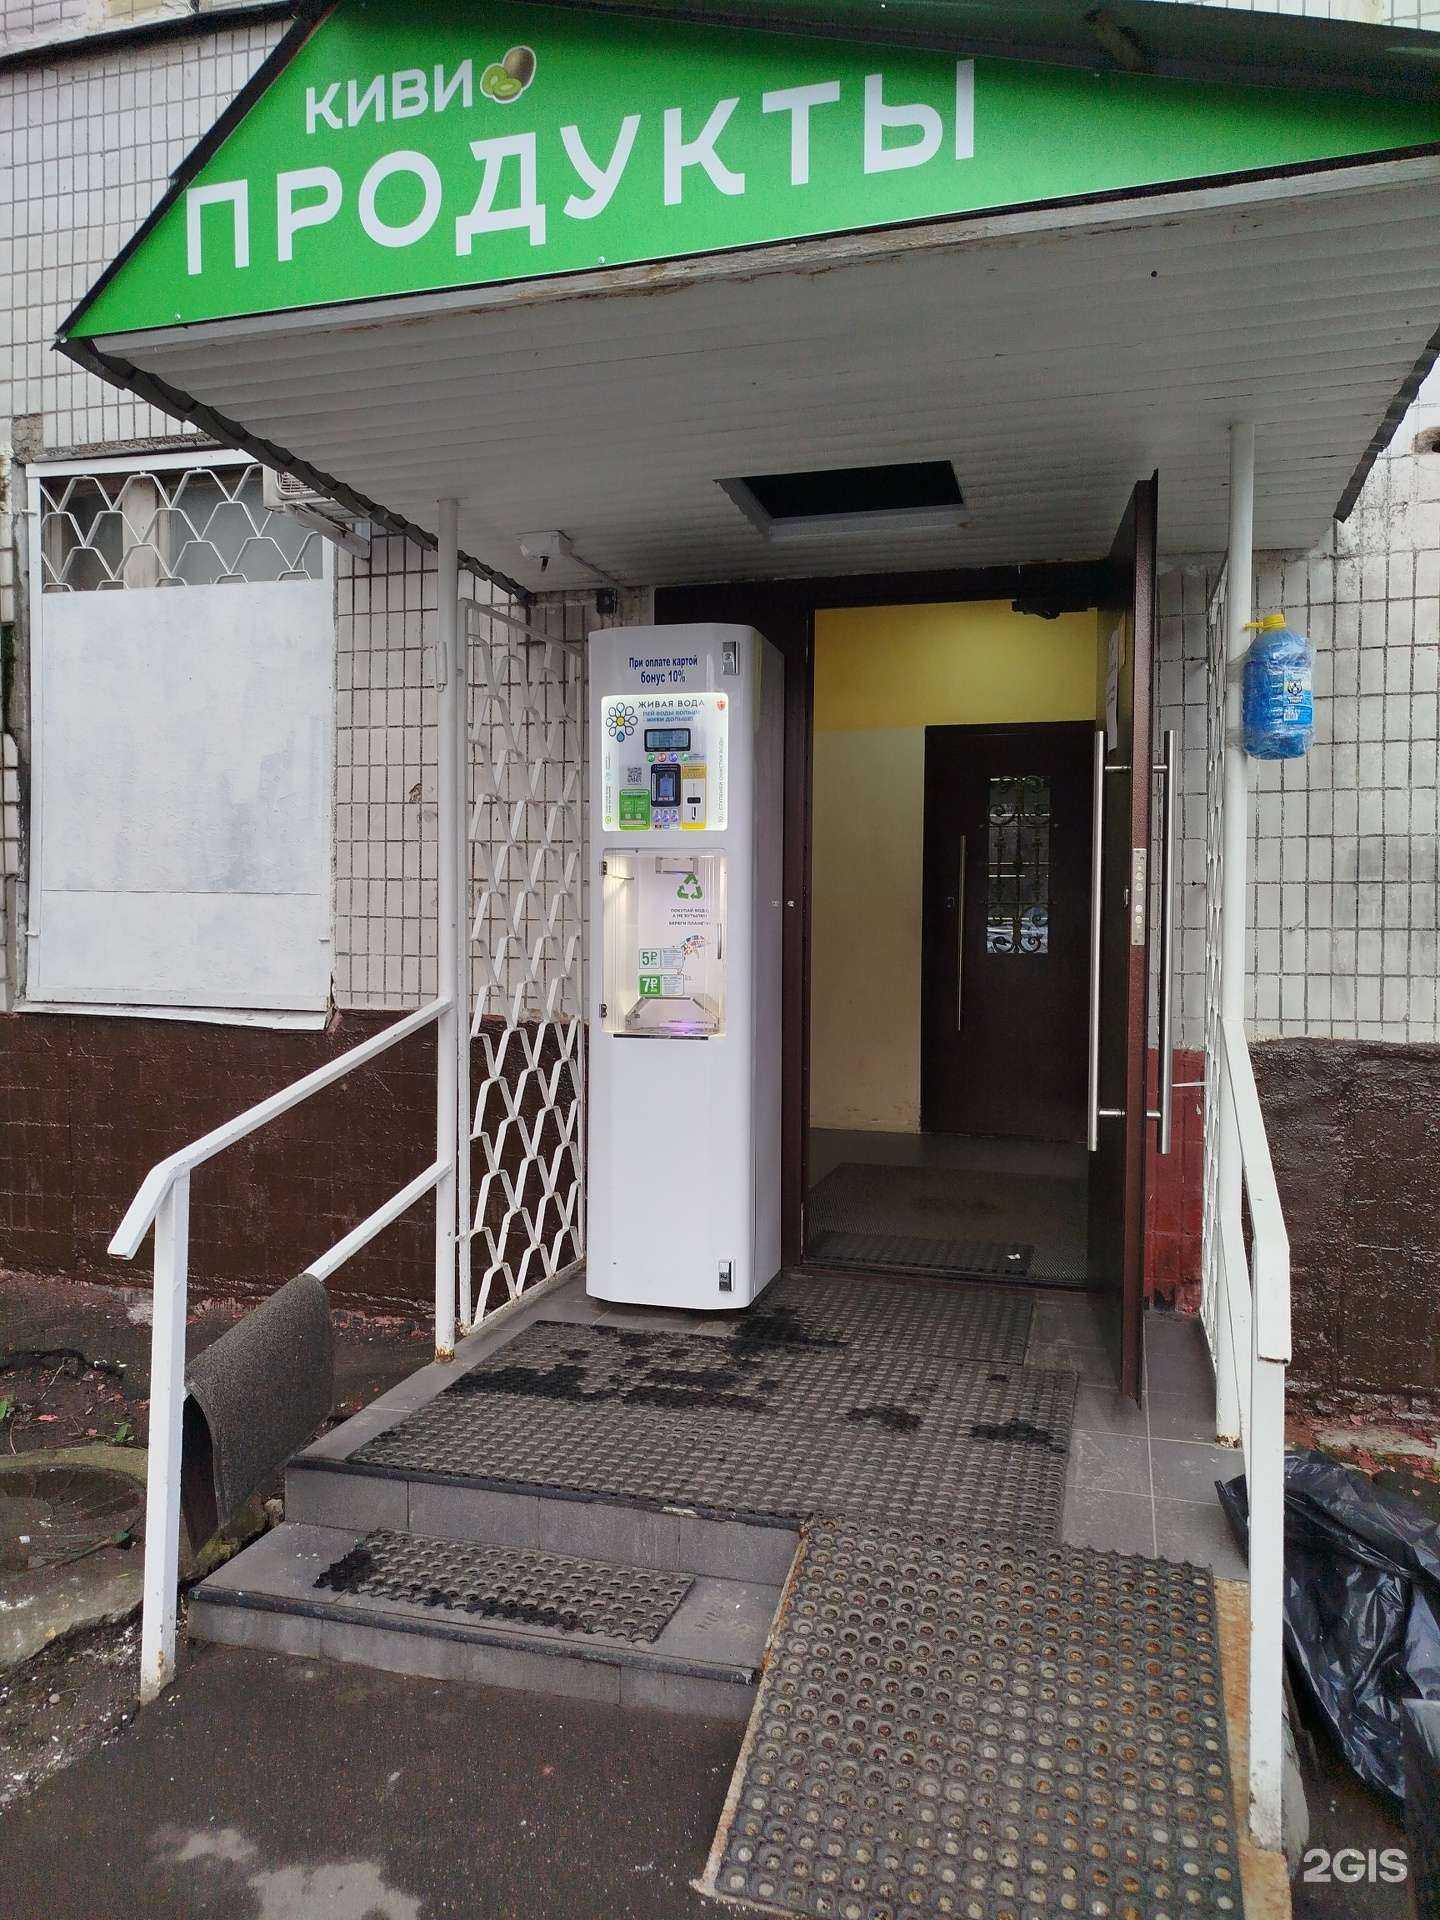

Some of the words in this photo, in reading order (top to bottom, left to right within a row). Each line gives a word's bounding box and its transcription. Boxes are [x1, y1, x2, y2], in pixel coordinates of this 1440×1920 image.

[305, 59, 473, 133] КИВИ
[186, 58, 975, 275] ПРОДУКТЫ
[629, 657, 643, 670] При
[645, 659, 671, 668] оплате
[672, 655, 698, 669] картой
[640, 671, 666, 686] бонус
[668, 670, 686, 682] 10%
[638, 700, 674, 709] ЖИВАЯ
[677, 699, 705, 708] ВОДА
